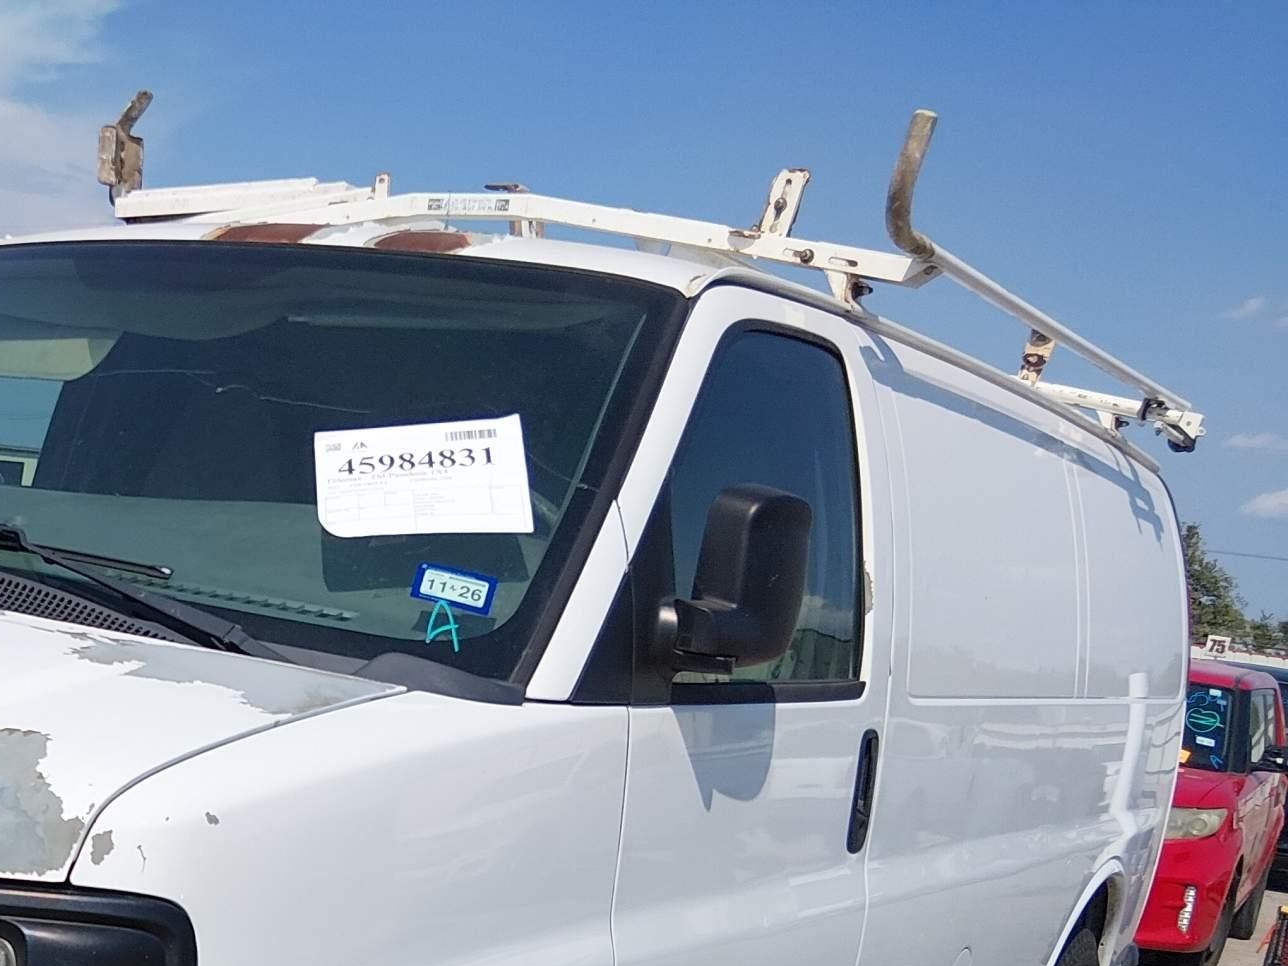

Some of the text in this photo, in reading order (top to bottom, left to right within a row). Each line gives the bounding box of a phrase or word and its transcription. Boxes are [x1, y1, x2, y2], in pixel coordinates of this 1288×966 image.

[337, 446, 496, 476] 45984831
[458, 585, 483, 602] 26
[425, 600, 460, 653] A
[1209, 639, 1227, 654] 75
